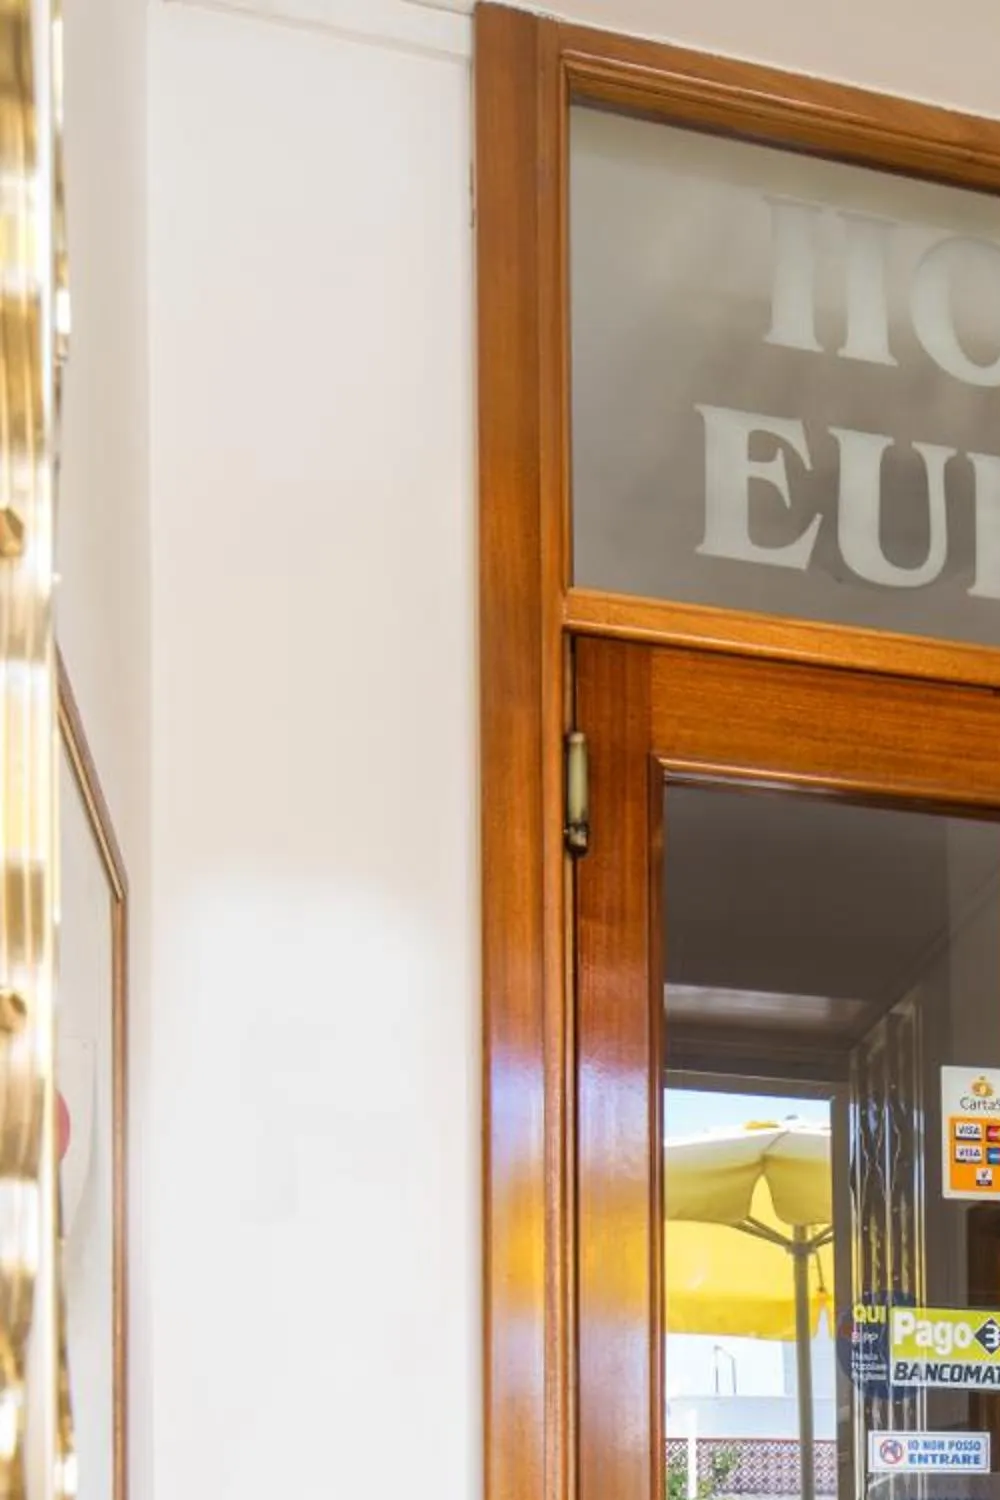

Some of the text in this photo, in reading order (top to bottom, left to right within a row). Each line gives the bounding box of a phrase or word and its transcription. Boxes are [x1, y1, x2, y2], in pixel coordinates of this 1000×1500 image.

[958, 1126, 981, 1135] VISA
[853, 1304, 886, 1324] QUI
[893, 1311, 974, 1355] Pago
[923, 1439, 944, 1451] NON
[948, 1439, 981, 1451] POSSO
[908, 1453, 981, 1465] ENTRARE
